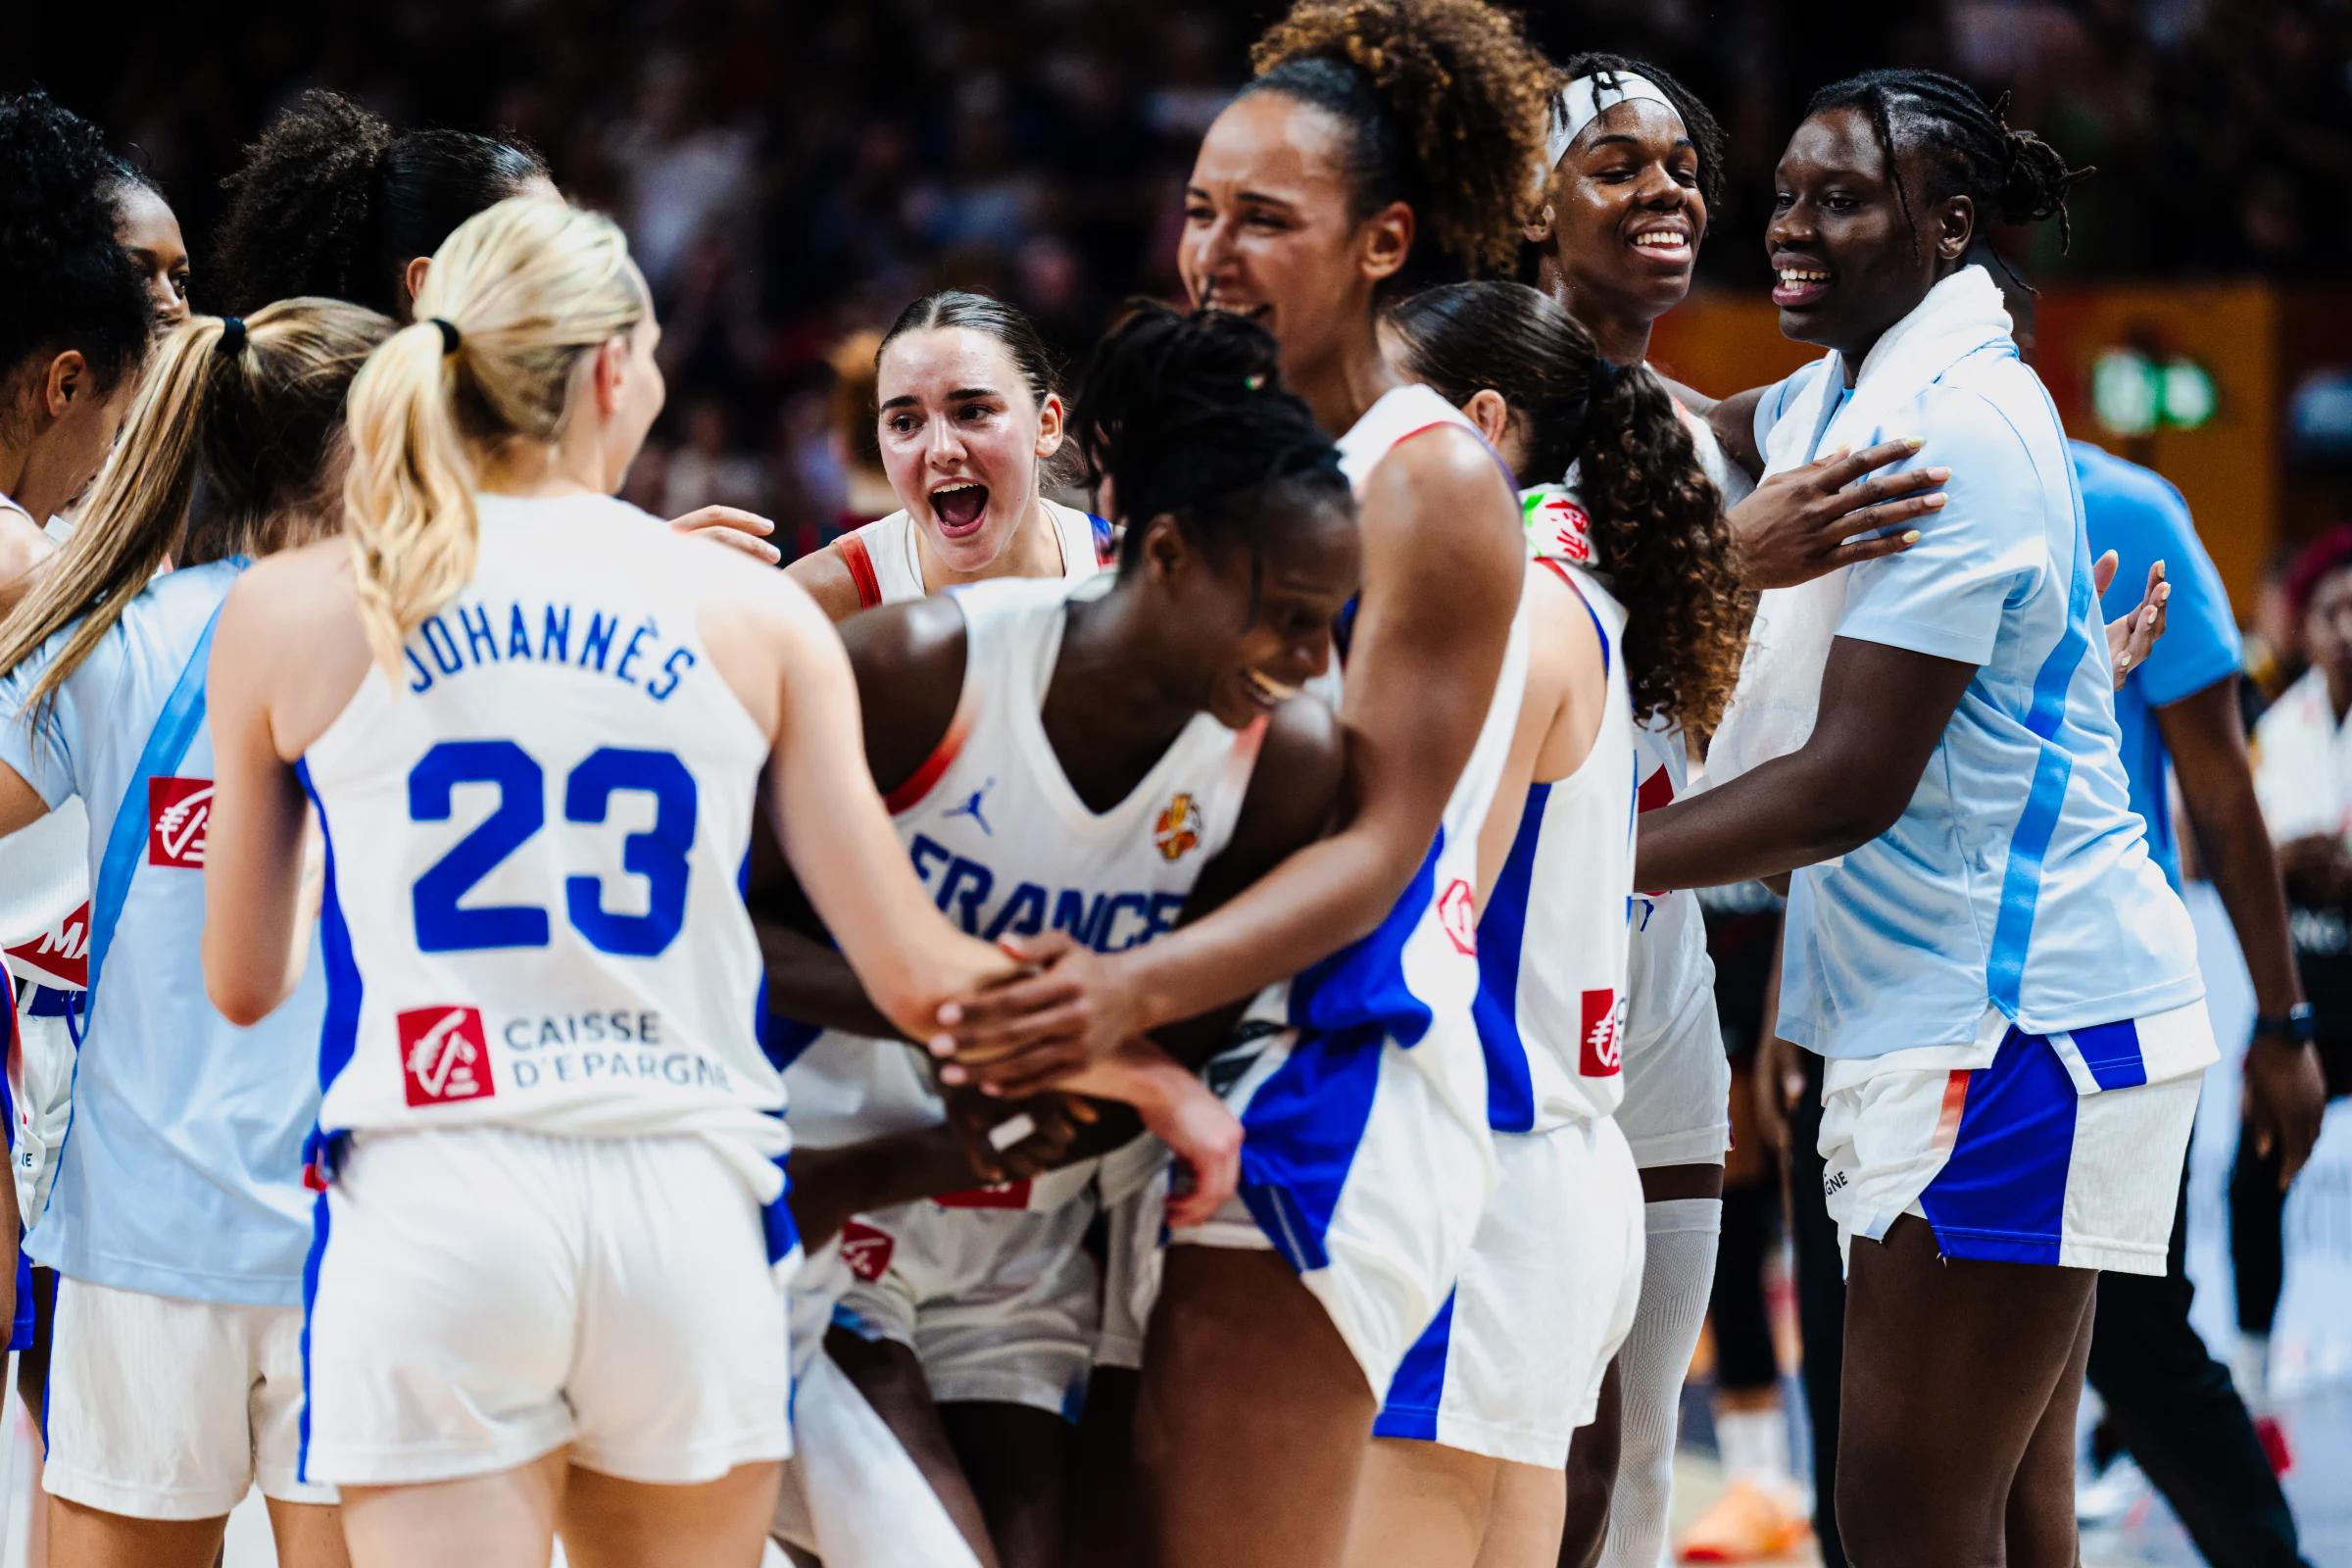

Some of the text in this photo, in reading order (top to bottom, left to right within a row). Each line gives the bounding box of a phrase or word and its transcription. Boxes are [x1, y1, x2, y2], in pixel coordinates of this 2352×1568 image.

[404, 601, 695, 702] JOHANNÈS
[408, 738, 698, 957] 23
[909, 833, 1188, 955] FRANCE
[504, 1010, 663, 1052] CAISSE
